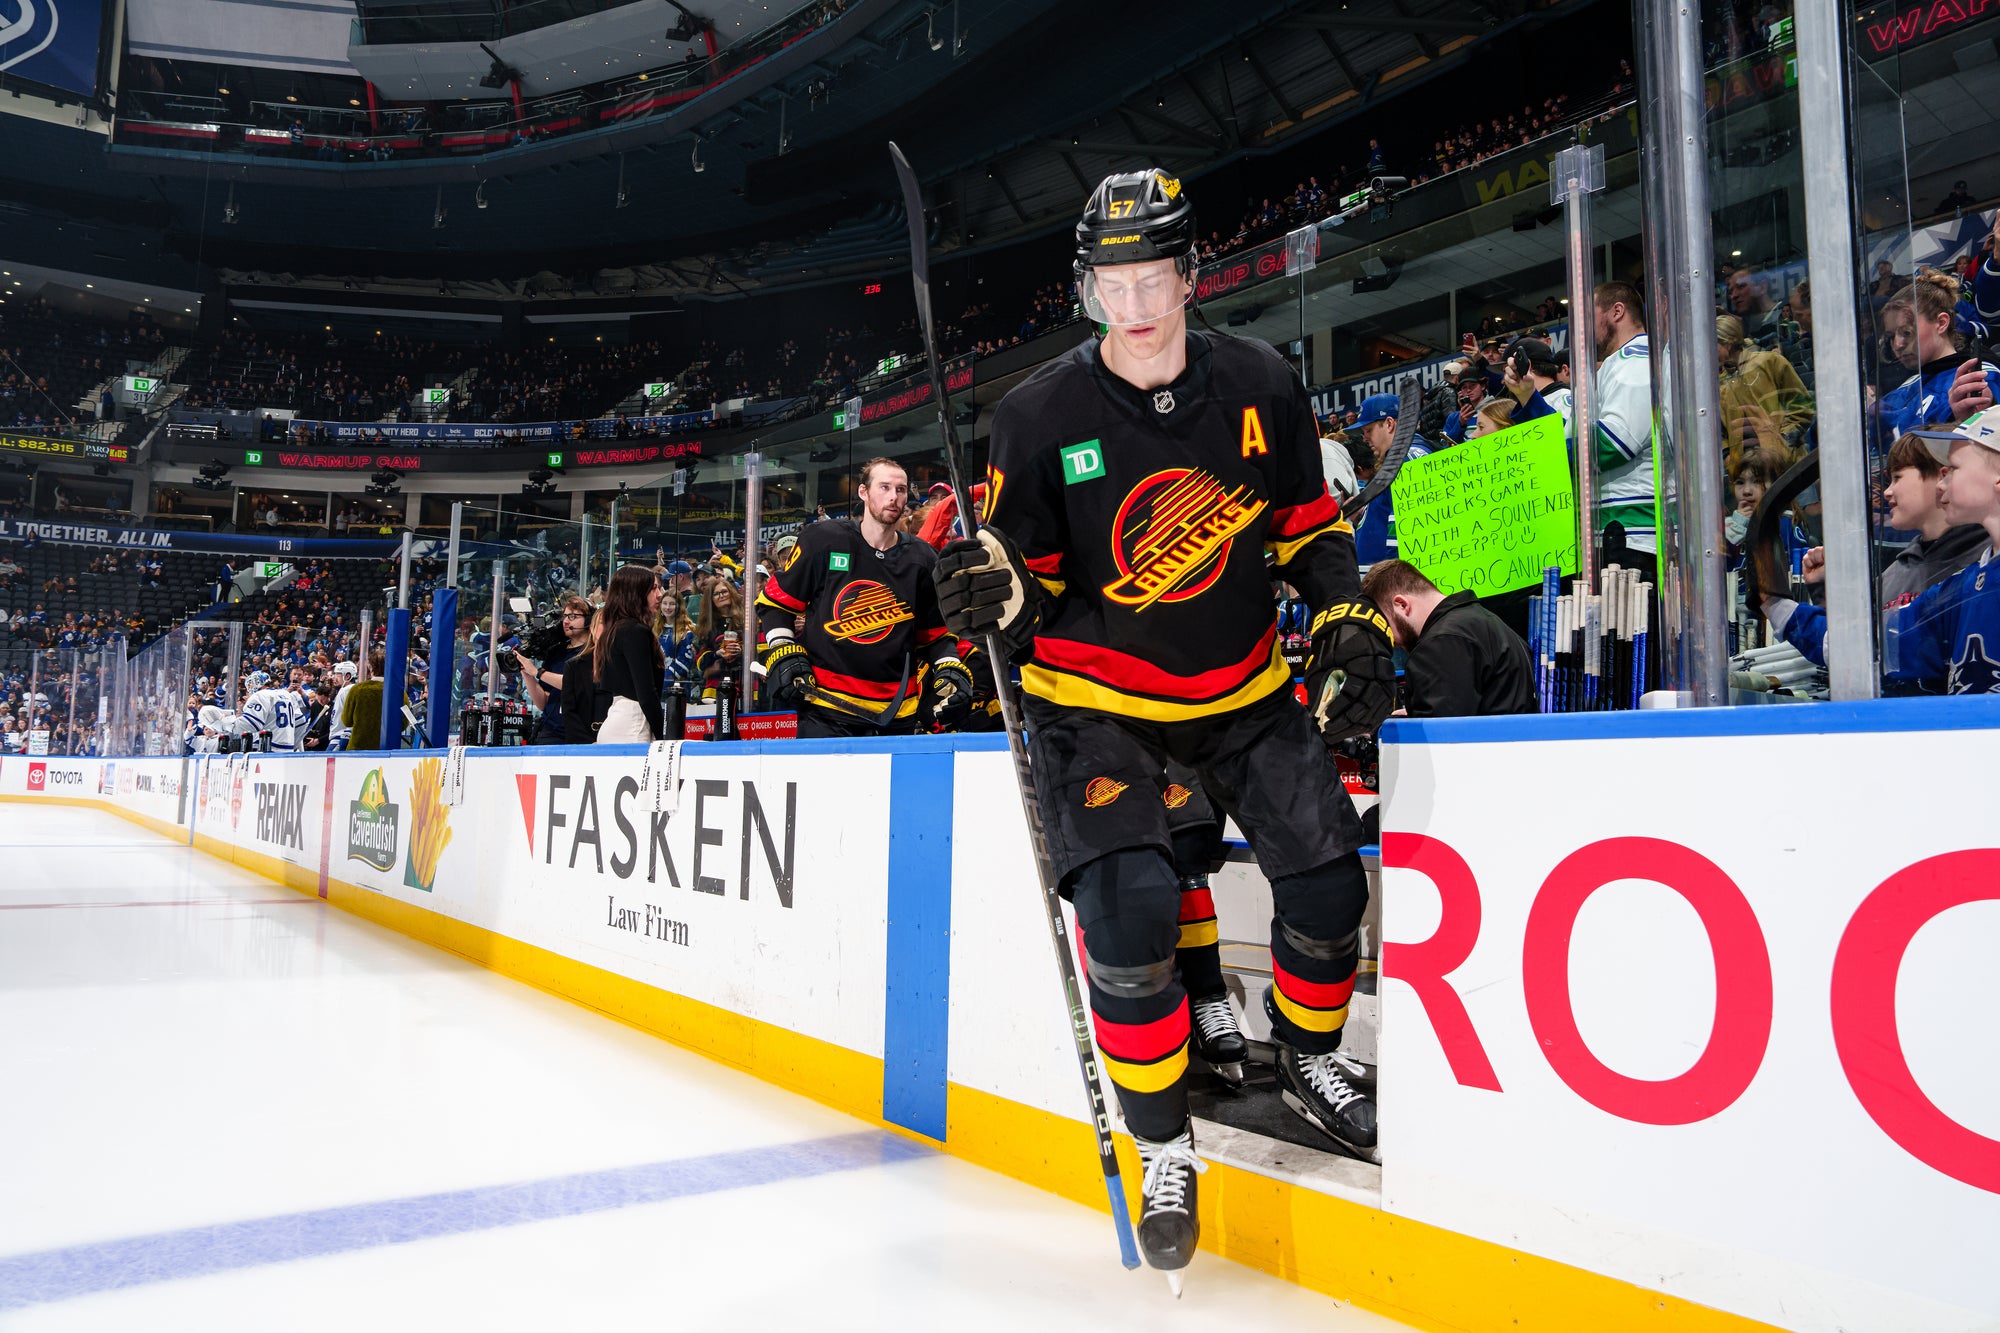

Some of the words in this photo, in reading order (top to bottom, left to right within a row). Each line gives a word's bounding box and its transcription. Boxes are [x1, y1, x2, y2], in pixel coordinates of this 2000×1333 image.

[1109, 199, 1135, 219] 57
[1101, 234, 1141, 246] BAUER
[863, 283, 881, 295] 336
[136, 380, 148, 389] TD
[860, 384, 933, 422] WARMUP
[944, 367, 973, 392] AM
[1311, 389, 1346, 417] ALL
[338, 427, 357, 436] BCLC
[400, 428, 419, 436] HERO
[474, 428, 493, 437] BCLC
[534, 426, 552, 435] HERO
[1242, 405, 1268, 459] A
[18, 438, 75, 453] $82,315
[86, 445, 110, 455] PARQ
[576, 447, 660, 465] WARMUP
[662, 442, 702, 458] CAM
[1423, 443, 1483, 476] MEMORY
[1494, 425, 1545, 451] SUCKS
[247, 453, 261, 463] TD
[279, 453, 373, 468] WARMUP
[375, 454, 421, 469] CAM
[550, 455, 561, 465] TD
[1066, 448, 1099, 476] TD
[1394, 478, 1437, 500] WILL
[1440, 468, 1463, 485] YOU
[1467, 457, 1501, 477] HELP
[1506, 450, 1529, 466] ME
[1398, 485, 1455, 515] REMBER
[1463, 478, 1484, 494] MY
[1491, 463, 1535, 484] FIRST
[1398, 493, 1487, 537] CANUCKS
[1490, 477, 1541, 503] GAME
[1404, 526, 1460, 556] WITH
[1472, 520, 1484, 536] A
[1490, 491, 1573, 532] SOUVENIR
[16, 521, 112, 544] TOGETHER.
[117, 531, 147, 546] ALL
[150, 533, 172, 547] IN.
[632, 537, 643, 550] 114
[714, 530, 737, 546] ALL
[279, 539, 292, 551] 113
[1102, 498, 1268, 606] CANUCKS
[833, 555, 848, 568] TD
[1460, 567, 1486, 591] GO
[1488, 543, 1577, 589] CANUCKS
[823, 604, 915, 638] CANUCKS
[275, 701, 294, 728] 60
[780, 720, 798, 729] ROGERS
[690, 724, 705, 733] ROGERS
[756, 721, 773, 730] ROGERS
[50, 770, 83, 785] TOYOTA
[351, 813, 395, 853] Cavendish
[546, 774, 797, 909] FASKEN
[607, 895, 641, 934] Law
[644, 903, 690, 947] Firm
